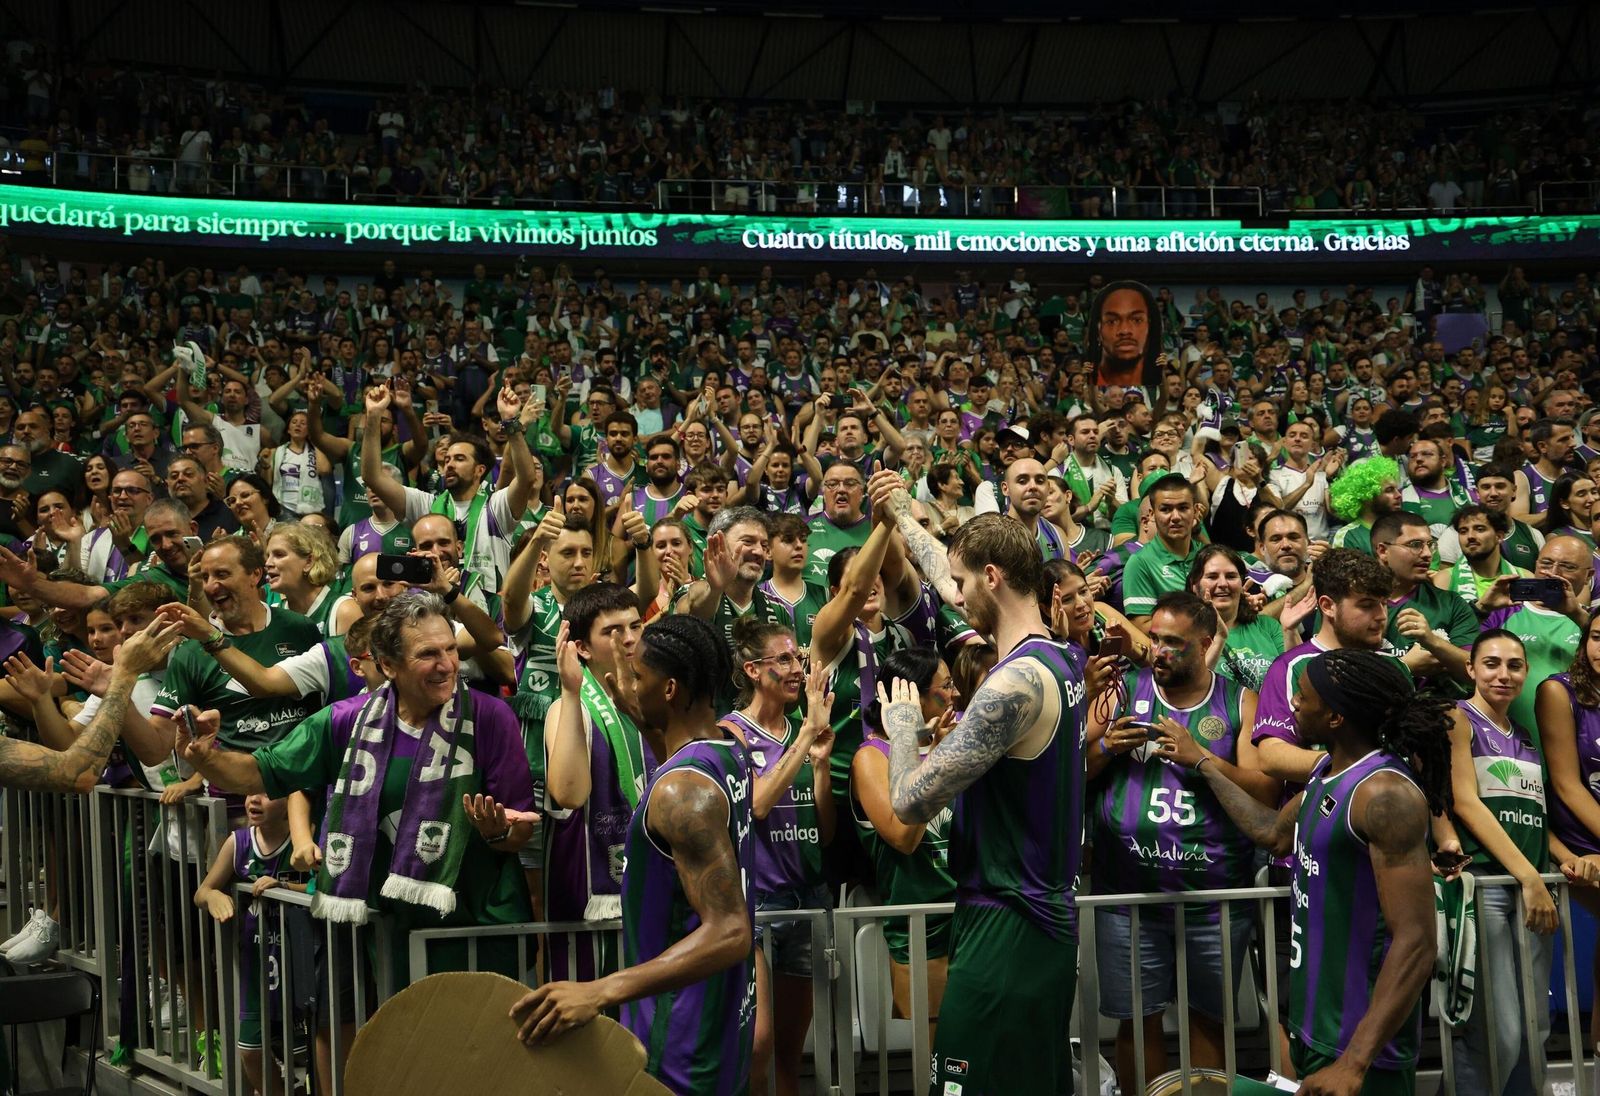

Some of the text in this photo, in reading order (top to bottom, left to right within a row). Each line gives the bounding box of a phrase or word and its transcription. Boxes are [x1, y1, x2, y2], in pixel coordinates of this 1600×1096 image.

[123, 210, 191, 235] para
[196, 211, 337, 242] siempre...
[344, 221, 442, 246] porque
[448, 220, 471, 243] la
[478, 222, 575, 246] vivimos
[579, 223, 657, 251] juntos
[742, 227, 1411, 257] Cuatro títulos, mil emociones y una afición eterna. Gracias
[1147, 787, 1196, 826] 55
[1128, 836, 1215, 863] Andalucía
[946, 1064, 963, 1074] acb
